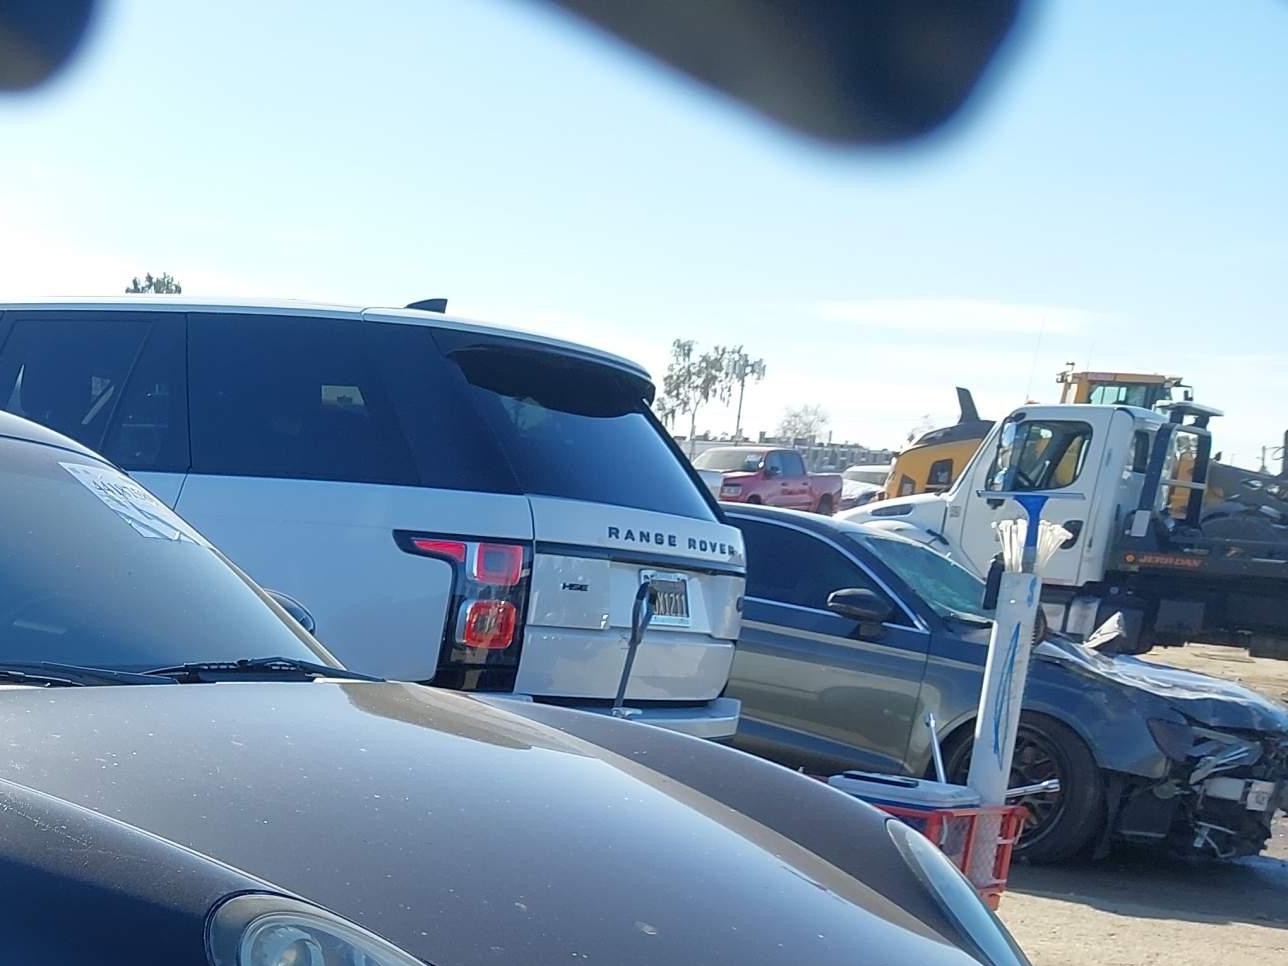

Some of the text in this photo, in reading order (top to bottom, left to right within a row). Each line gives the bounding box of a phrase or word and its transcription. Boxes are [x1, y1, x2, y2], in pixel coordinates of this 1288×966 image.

[608, 526, 735, 556] RANGE ROVER
[562, 582, 589, 592] HSE
